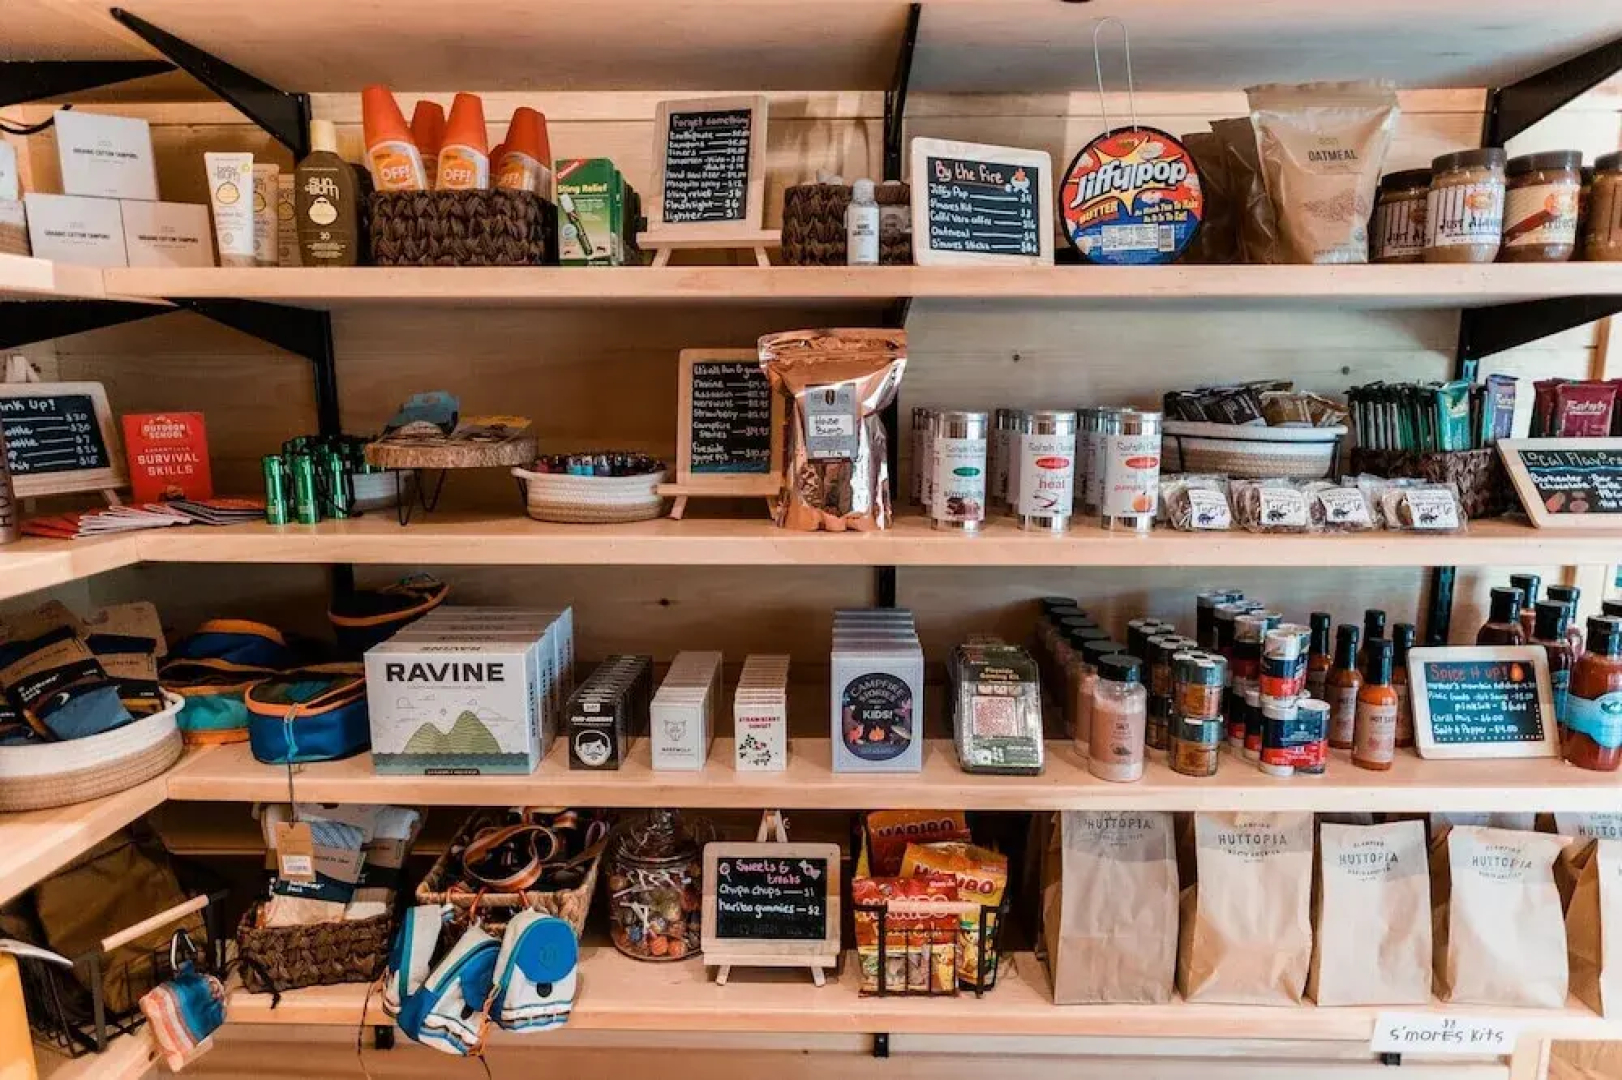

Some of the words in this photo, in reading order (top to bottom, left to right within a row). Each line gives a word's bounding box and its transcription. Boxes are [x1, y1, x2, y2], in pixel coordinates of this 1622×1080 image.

[1308, 149, 1359, 162] OATMEAL
[383, 166, 410, 180] OFF!
[444, 168, 472, 183] OFF!
[934, 160, 952, 182] By
[954, 162, 975, 181] the
[581, 183, 608, 193] Relief
[1079, 201, 1119, 224] BUTTER
[930, 226, 970, 239] Oatmeal
[143, 424, 187, 434] OUTDOOR
[149, 431, 183, 440] SCHOOL
[137, 453, 200, 465] SURVIVAL
[147, 464, 194, 477] SKILLS
[1039, 478, 1065, 490] heal
[385, 662, 505, 682] RAVINE
[850, 679, 907, 699] CAMPFIRE
[862, 709, 893, 720] KIDS!
[879, 818, 955, 838] HARIBO
[1087, 818, 1152, 830] HUTTOPIA
[1217, 834, 1288, 846] HUTTOPIA
[1339, 851, 1399, 866] HUTTOPIA
[1471, 855, 1533, 869] HUTTOPIA
[736, 859, 777, 873] Sweets
[767, 873, 801, 885] treats
[754, 901, 796, 918] gummies
